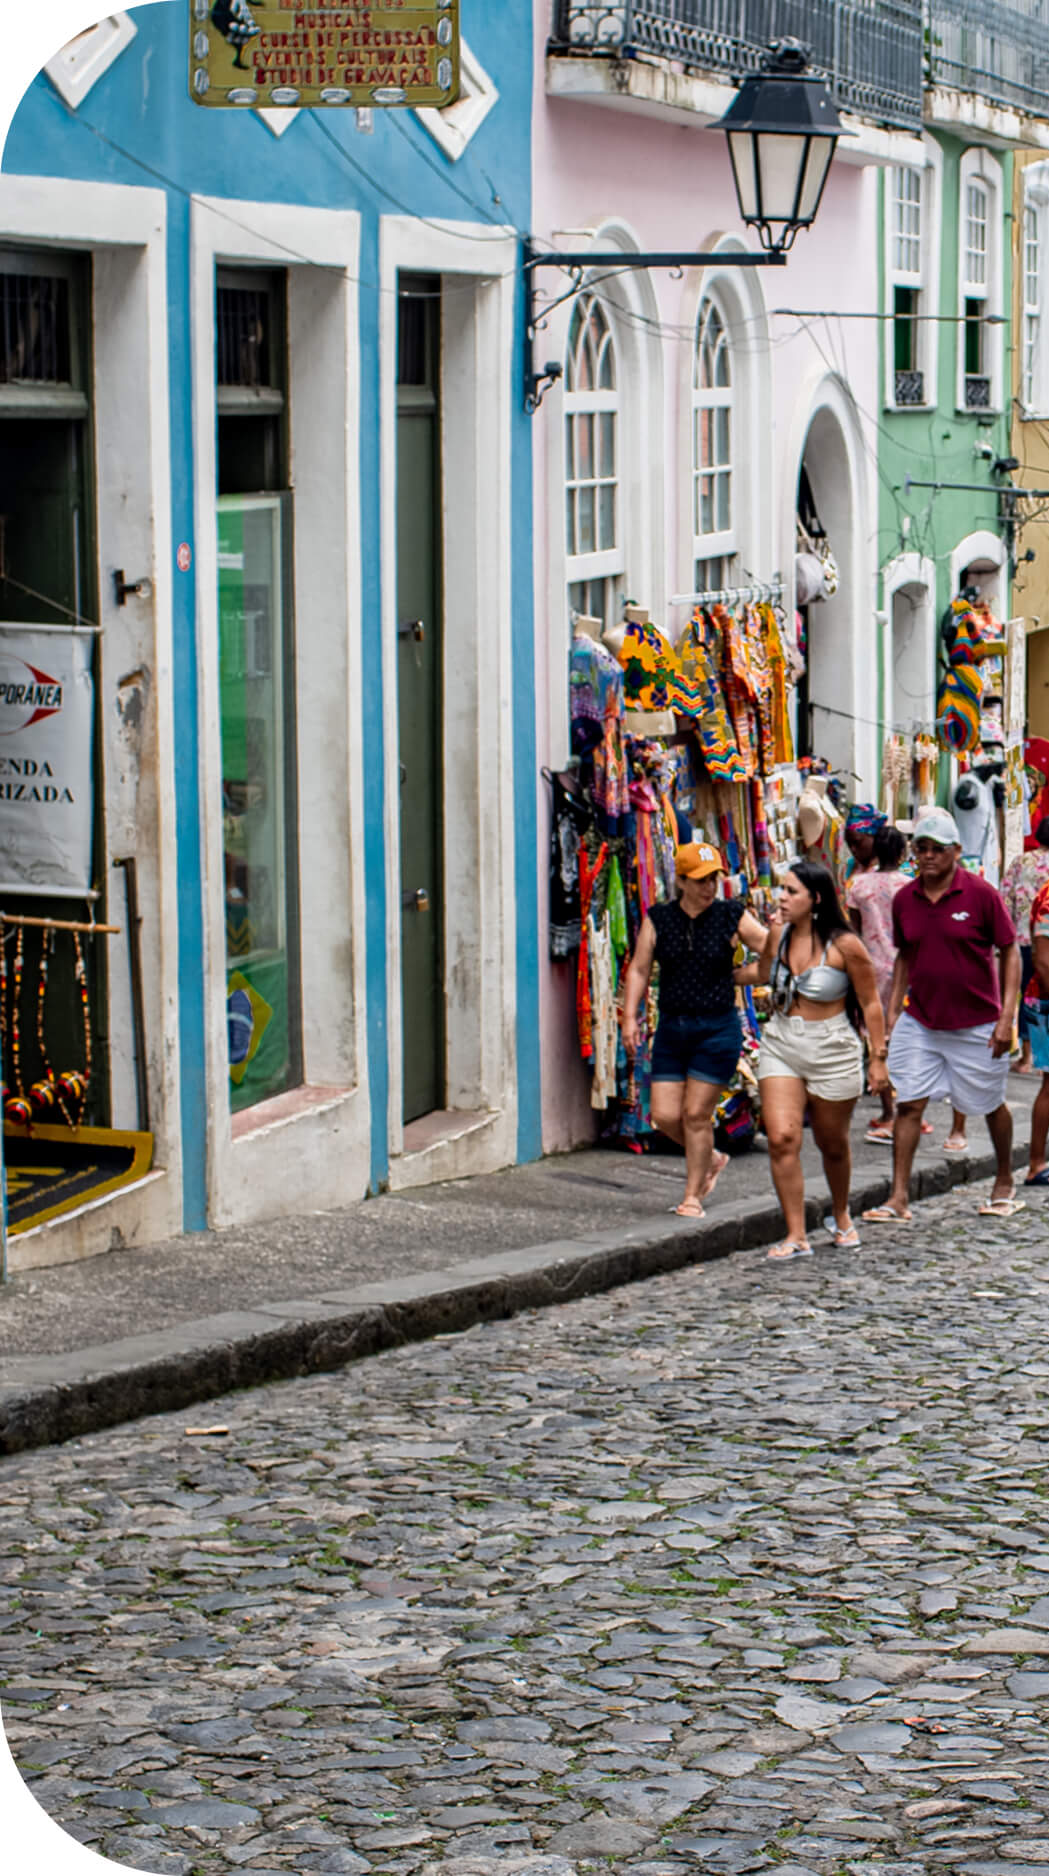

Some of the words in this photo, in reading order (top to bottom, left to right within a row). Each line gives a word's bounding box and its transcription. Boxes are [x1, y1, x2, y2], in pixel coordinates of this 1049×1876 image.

[294, 12, 372, 29] MUSICAIS
[259, 31, 310, 48] CURSO
[317, 31, 335, 48] DE
[340, 25, 435, 48] PERCUSSÃO
[252, 50, 326, 66] EVENTOS
[337, 49, 427, 66] CULTURAIS
[318, 67, 335, 84] DE
[344, 65, 433, 87] GRAVAÇÃO
